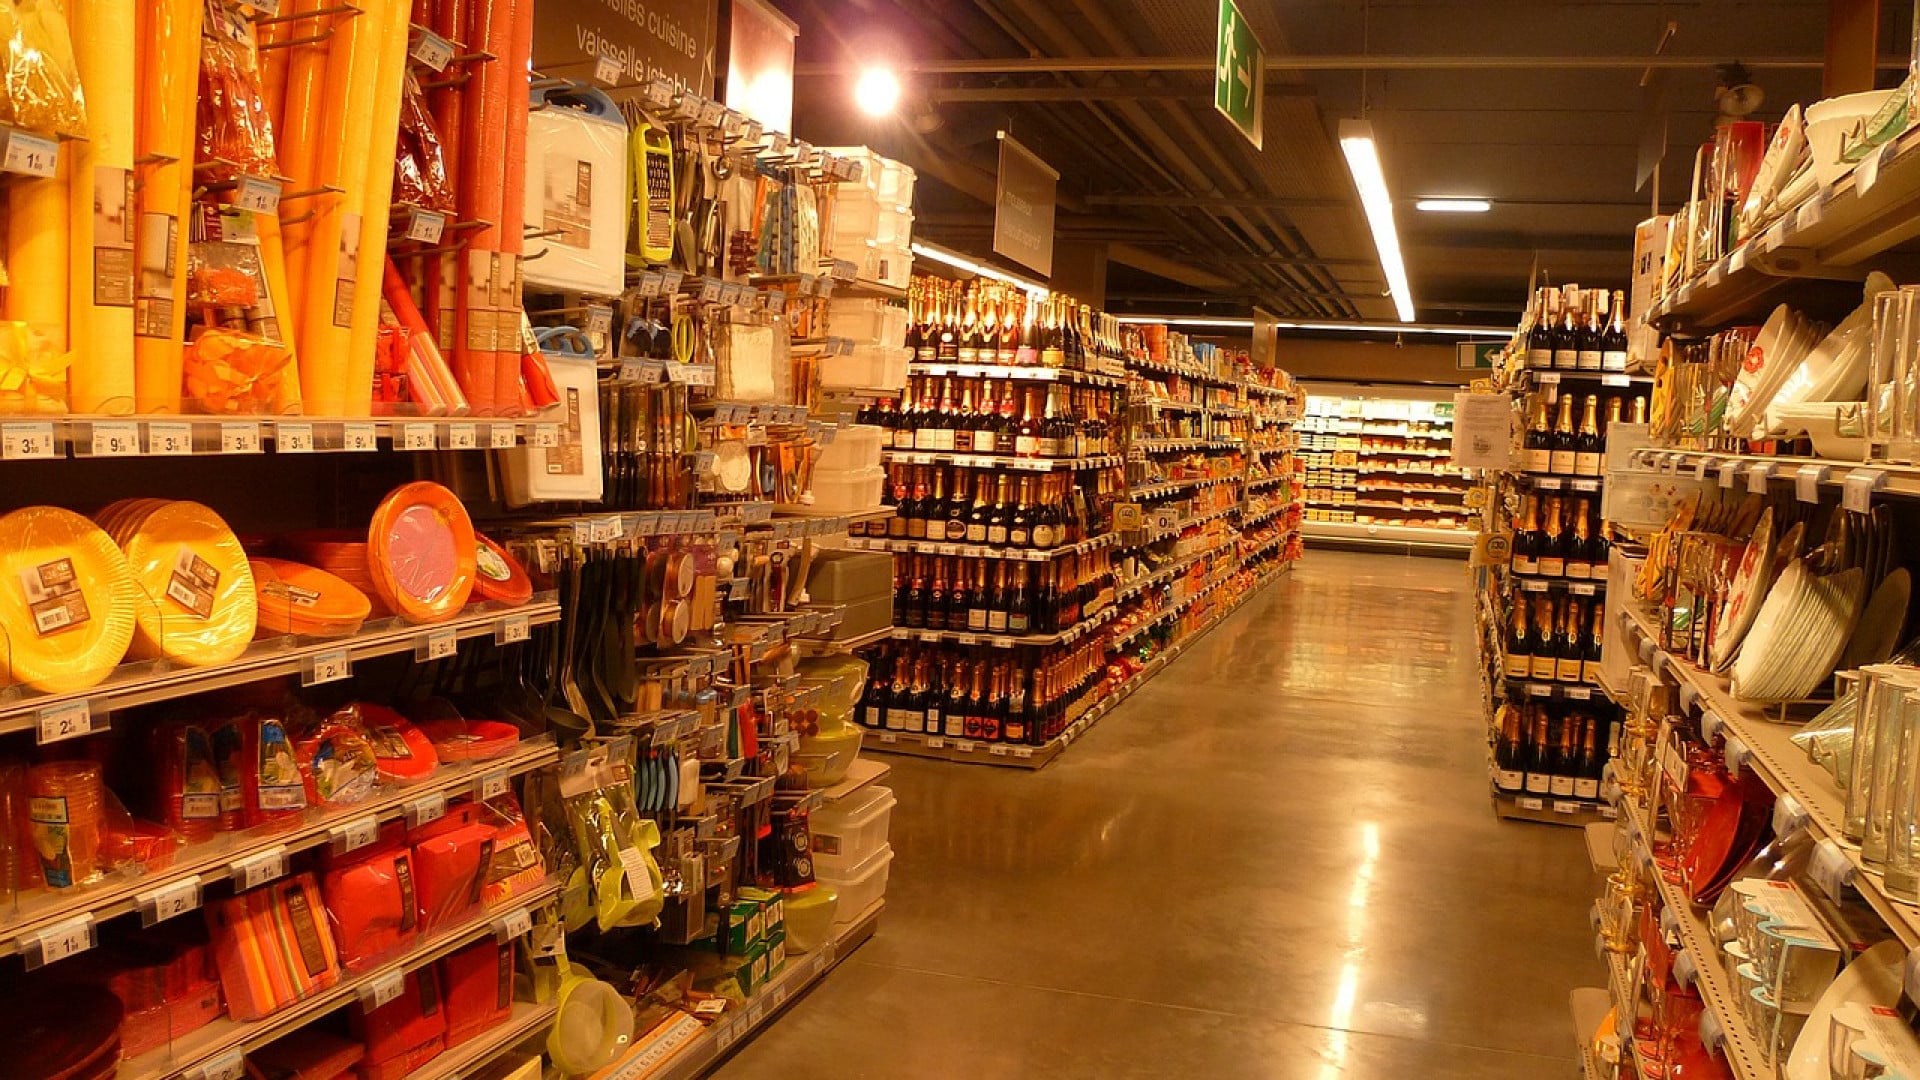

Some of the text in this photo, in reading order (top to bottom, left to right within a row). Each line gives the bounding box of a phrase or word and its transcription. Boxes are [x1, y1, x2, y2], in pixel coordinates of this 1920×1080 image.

[576, 23, 644, 82] vaisselle
[643, 56, 694, 96] jetbl
[601, 0, 697, 59] siles cuisine
